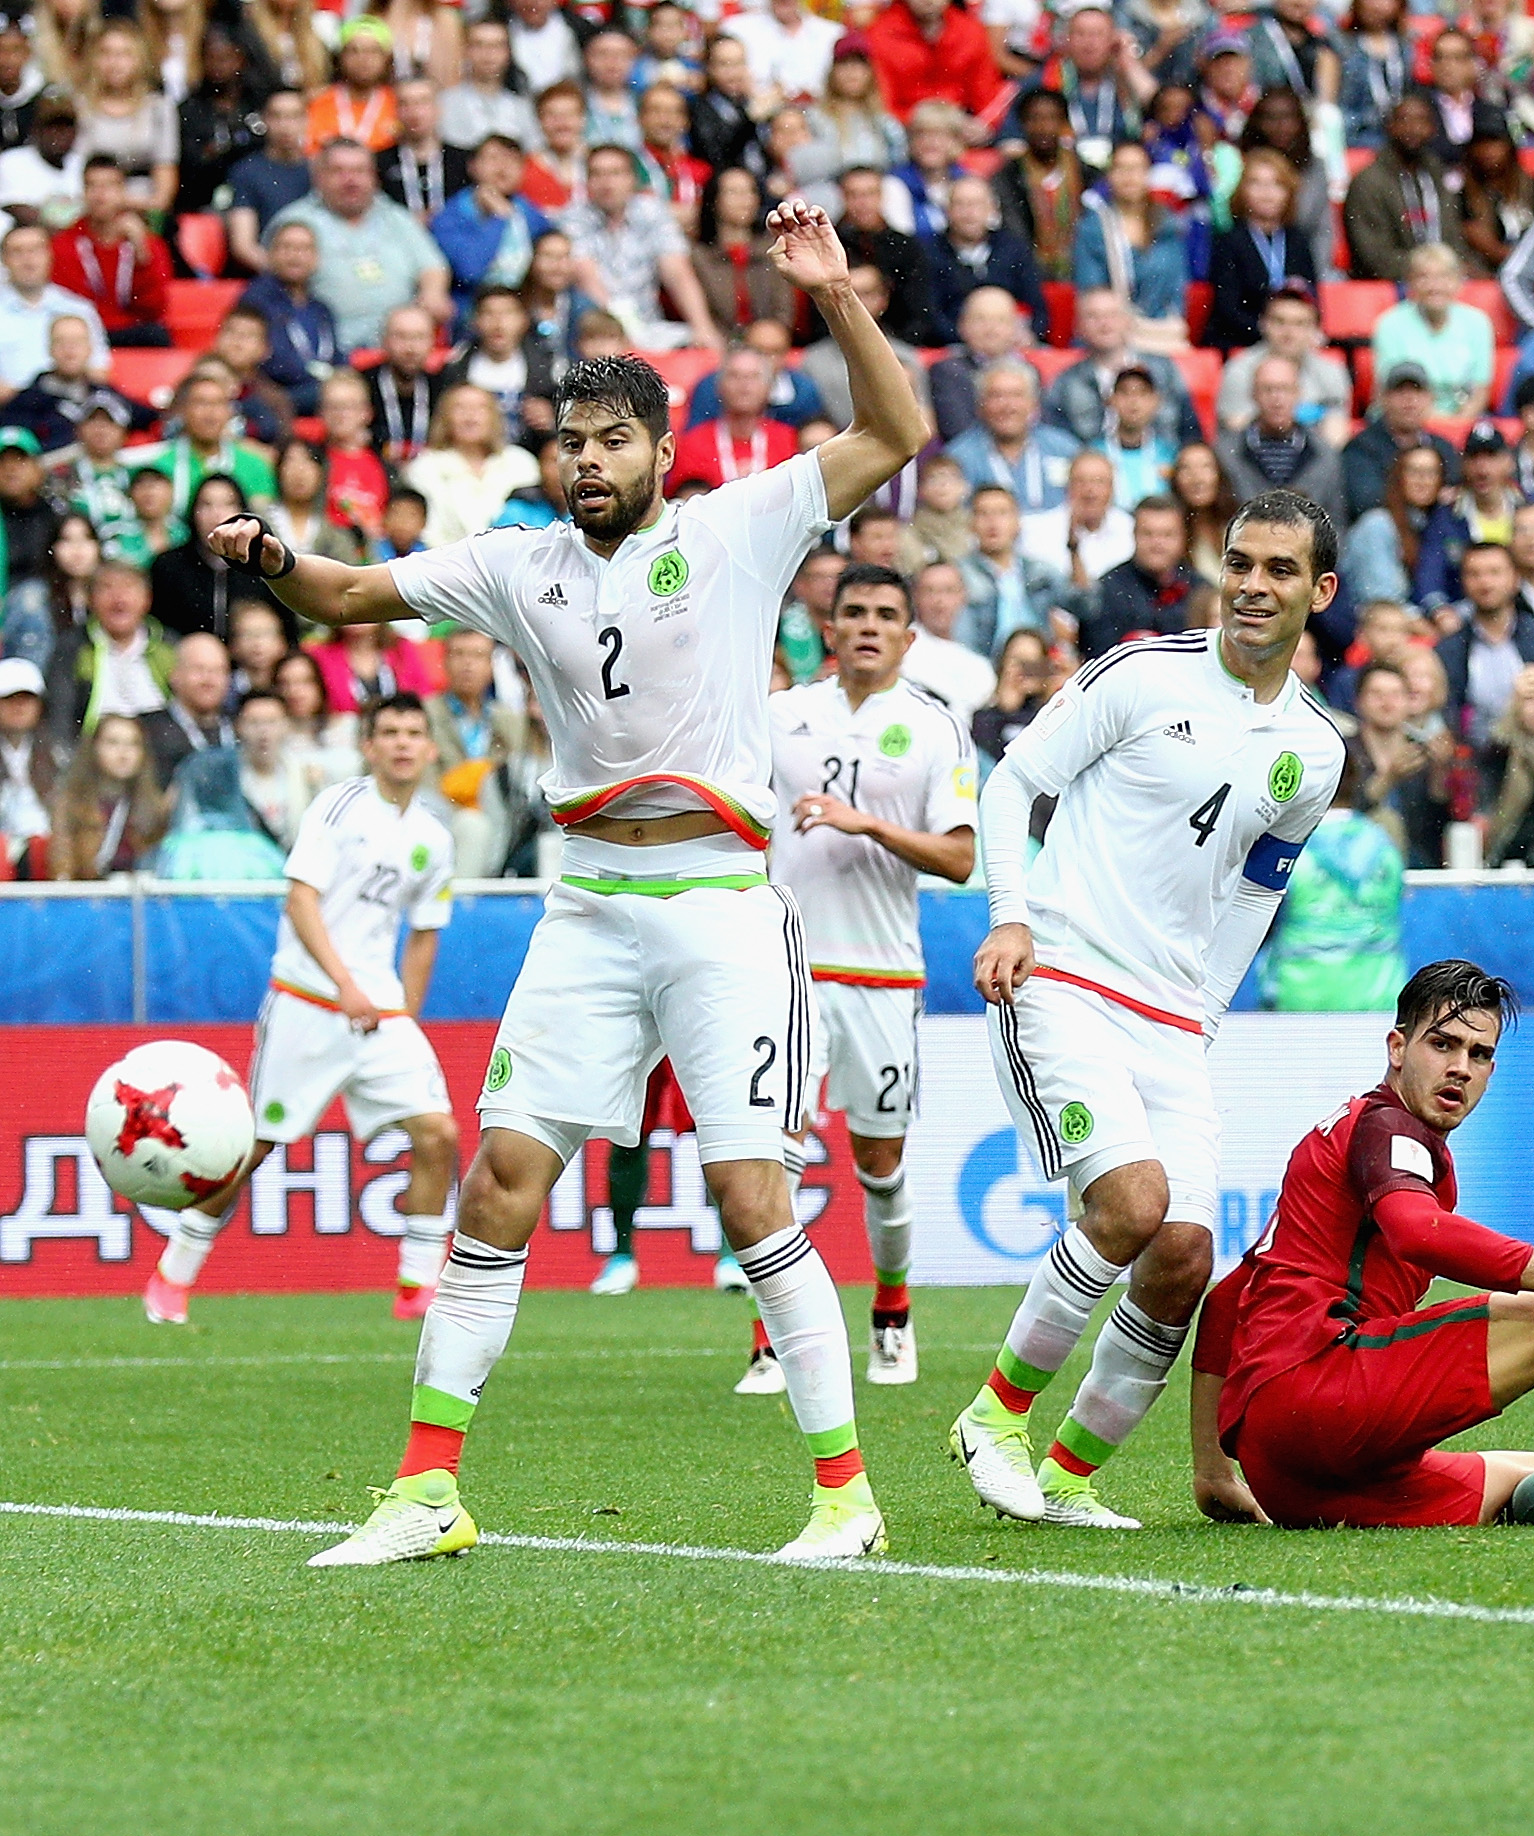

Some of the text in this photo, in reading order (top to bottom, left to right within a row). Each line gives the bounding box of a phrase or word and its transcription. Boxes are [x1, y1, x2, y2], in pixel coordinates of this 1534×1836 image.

[598, 626, 631, 700] 2
[821, 756, 860, 808] 21
[1189, 782, 1232, 847] 4
[749, 1036, 776, 1107] 2
